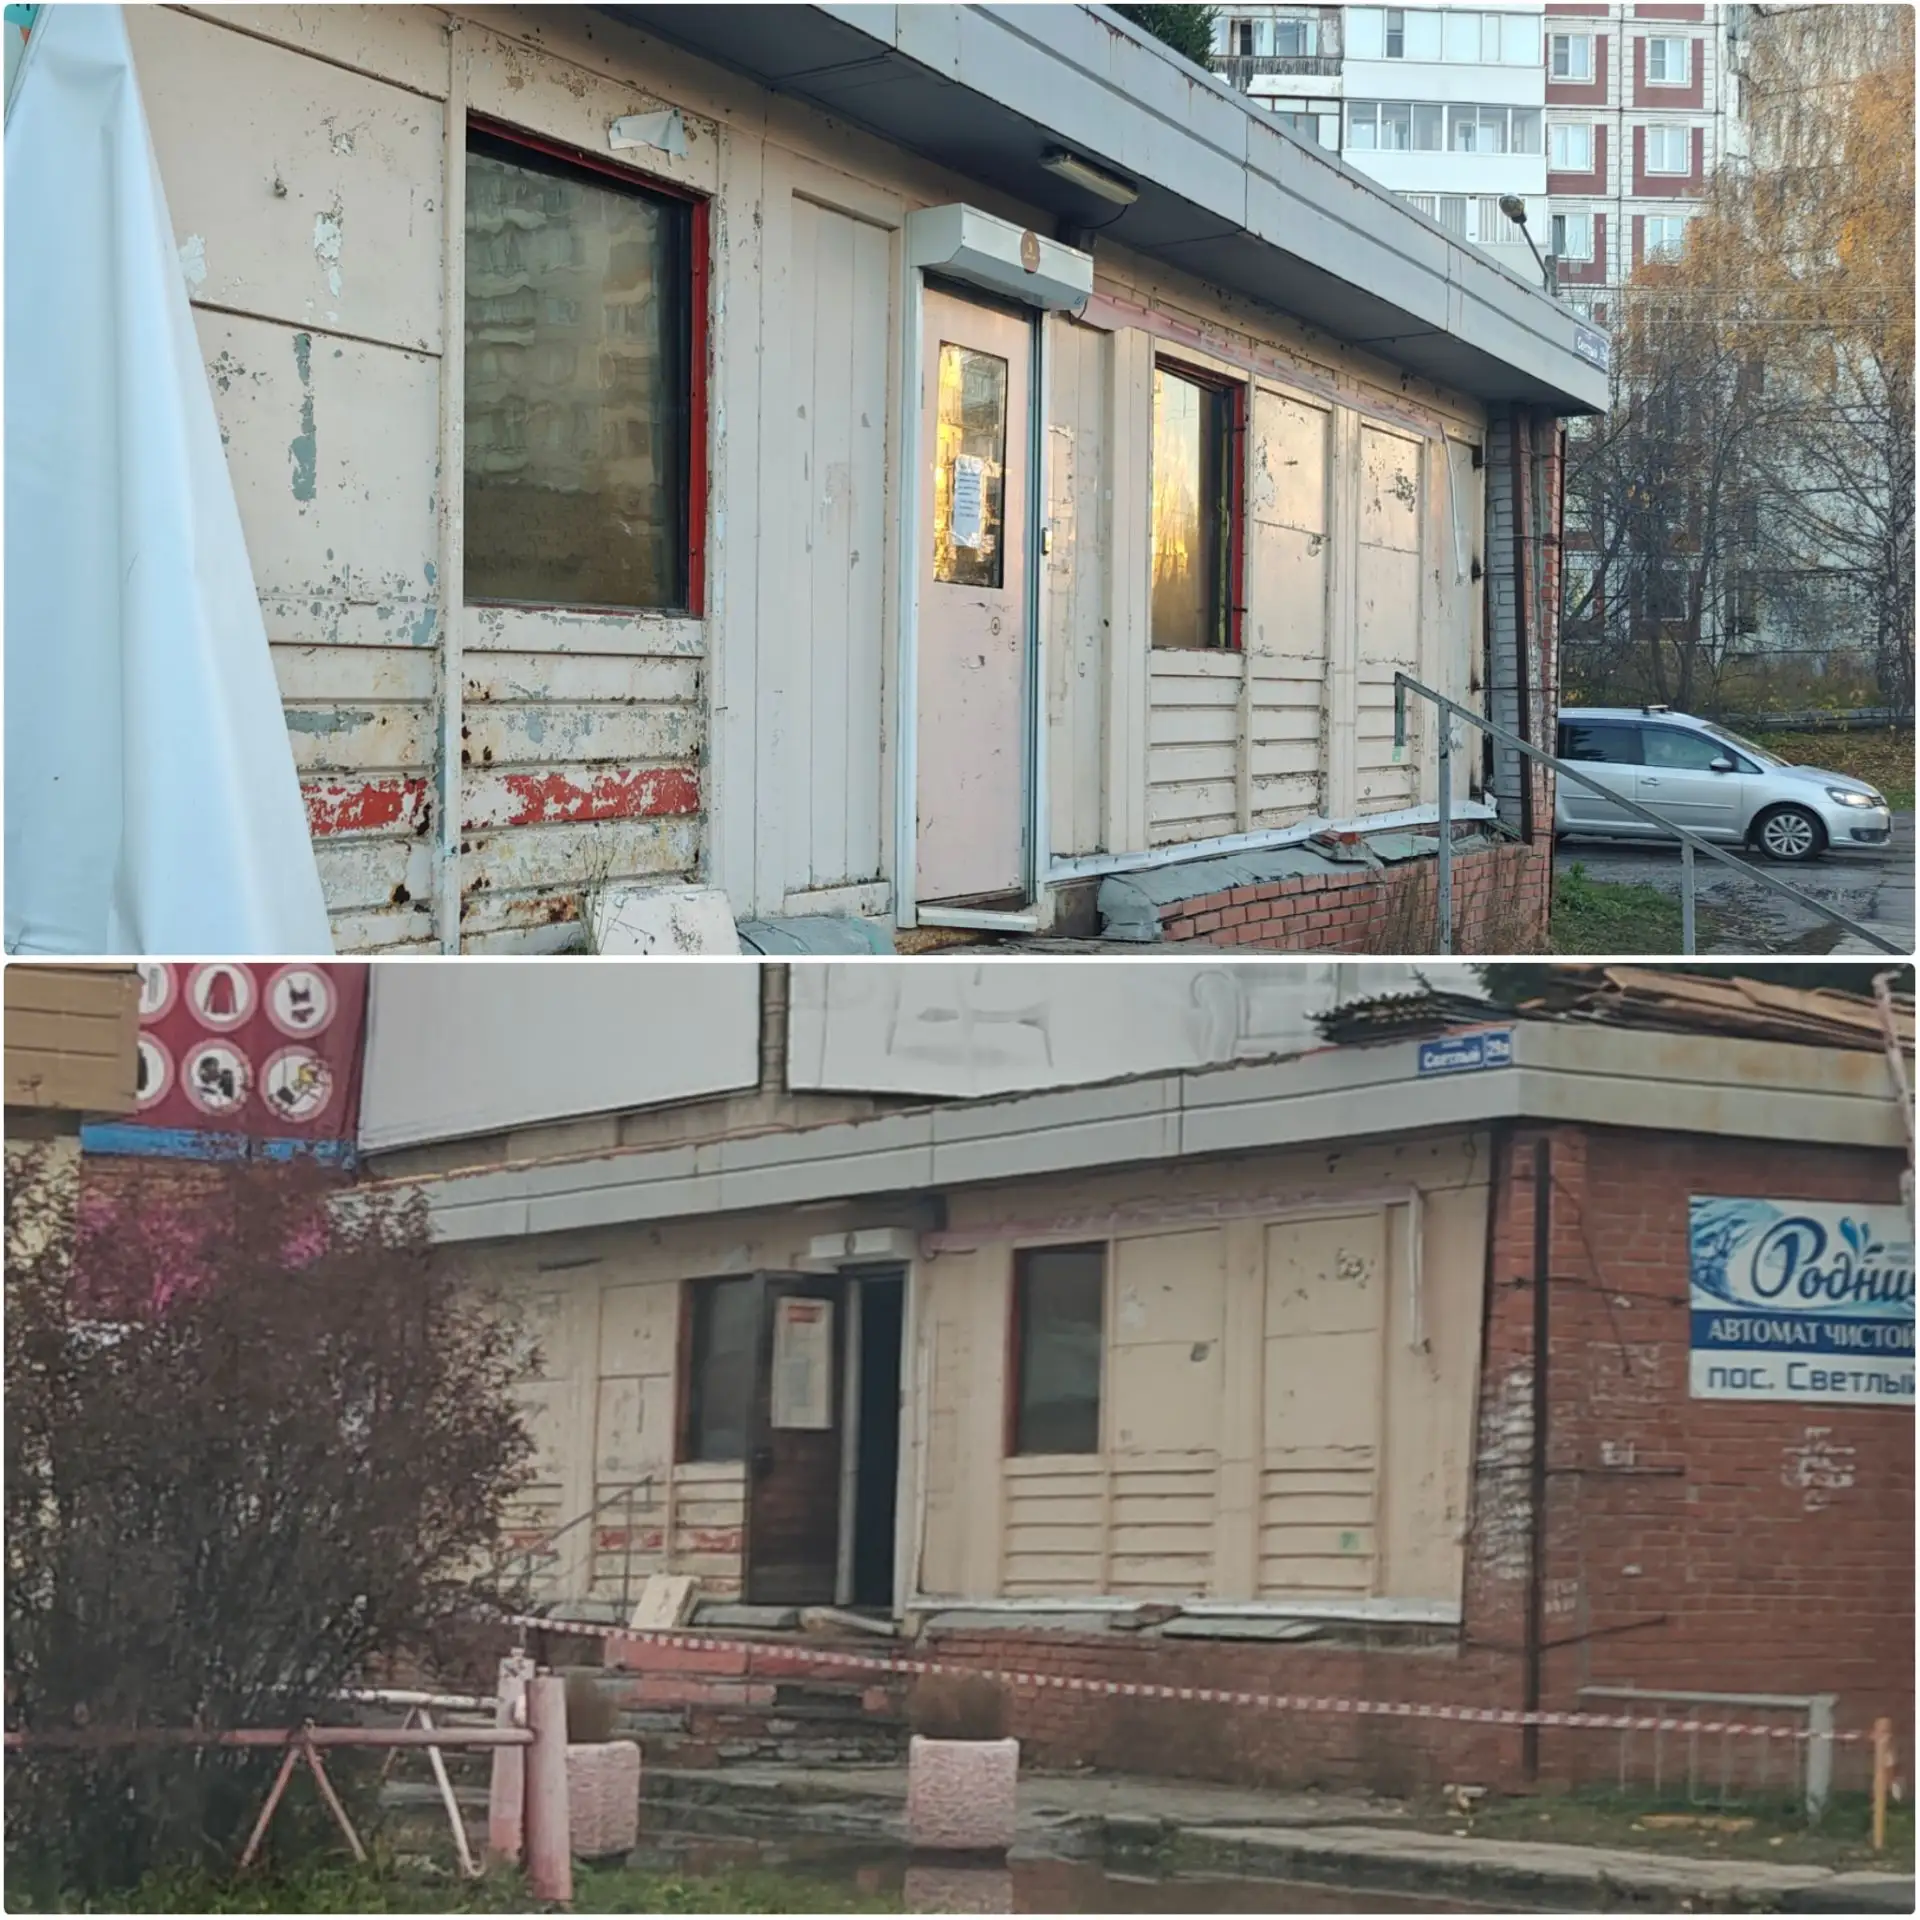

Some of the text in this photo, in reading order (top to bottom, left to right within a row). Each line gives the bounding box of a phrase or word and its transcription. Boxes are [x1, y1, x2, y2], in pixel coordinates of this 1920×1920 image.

[1751, 1215, 1915, 1300] Родни
[1708, 1317, 1820, 1345] АВТОМАТ
[1708, 1366, 1776, 1390] пос.
